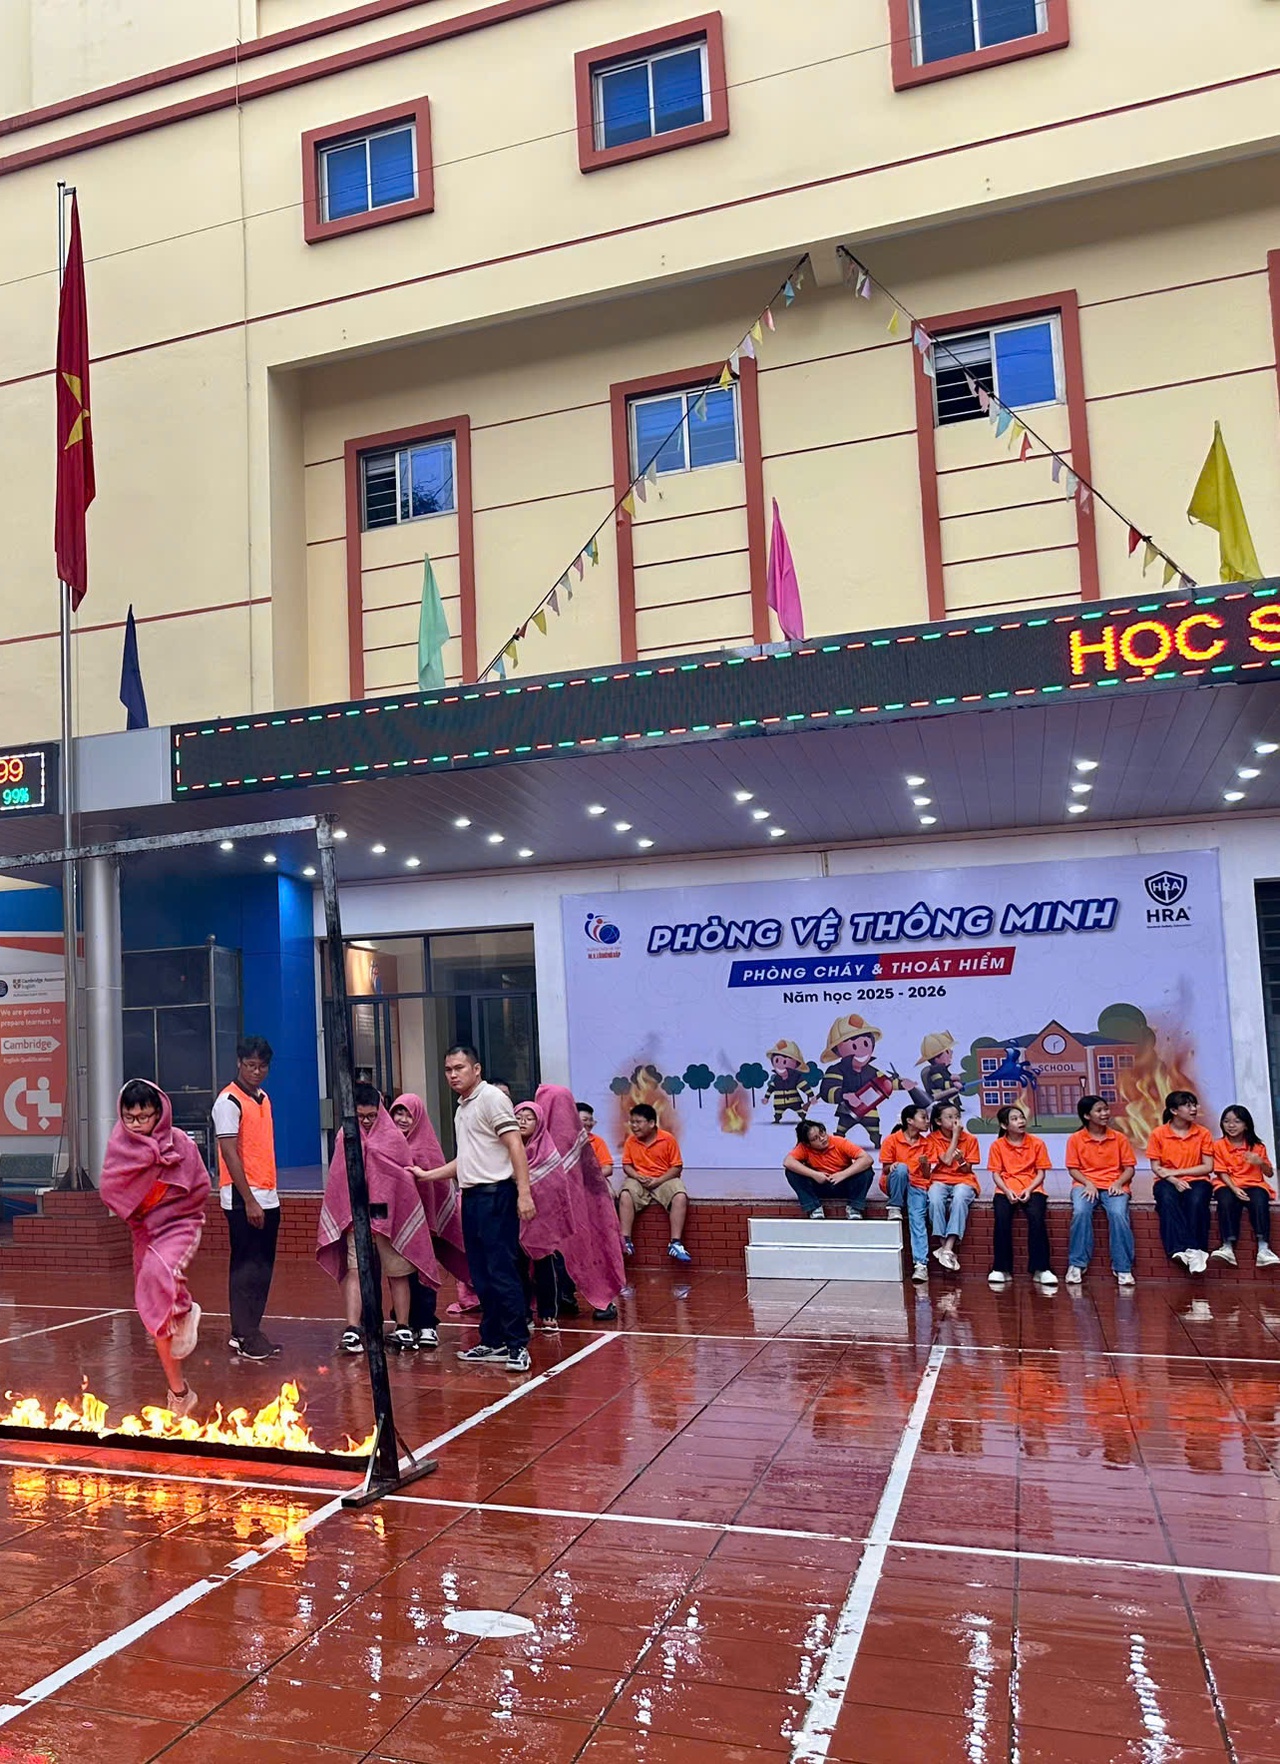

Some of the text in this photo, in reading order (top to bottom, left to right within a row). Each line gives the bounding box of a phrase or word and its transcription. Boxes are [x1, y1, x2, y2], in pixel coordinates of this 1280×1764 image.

[1070, 612, 1228, 677] HỌC
[2, 787, 29, 805] 99%
[1146, 907, 1190, 923] HRA
[648, 898, 1118, 955] PHÒNG VỆ THÔNG MINH
[742, 951, 1005, 981] PHÒNG CHÁY & THOÁT HIỂM
[783, 990, 819, 1004] Năm
[823, 990, 852, 1004] học
[857, 987, 894, 1001] 2025
[908, 985, 946, 999] 2026
[23, 1007, 41, 1017] proud
[0, 1020, 24, 1029] prepare
[25, 1018, 51, 1026] learners
[3, 1038, 52, 1051] Cambridge
[1038, 1063, 1076, 1072] SCHOOL
